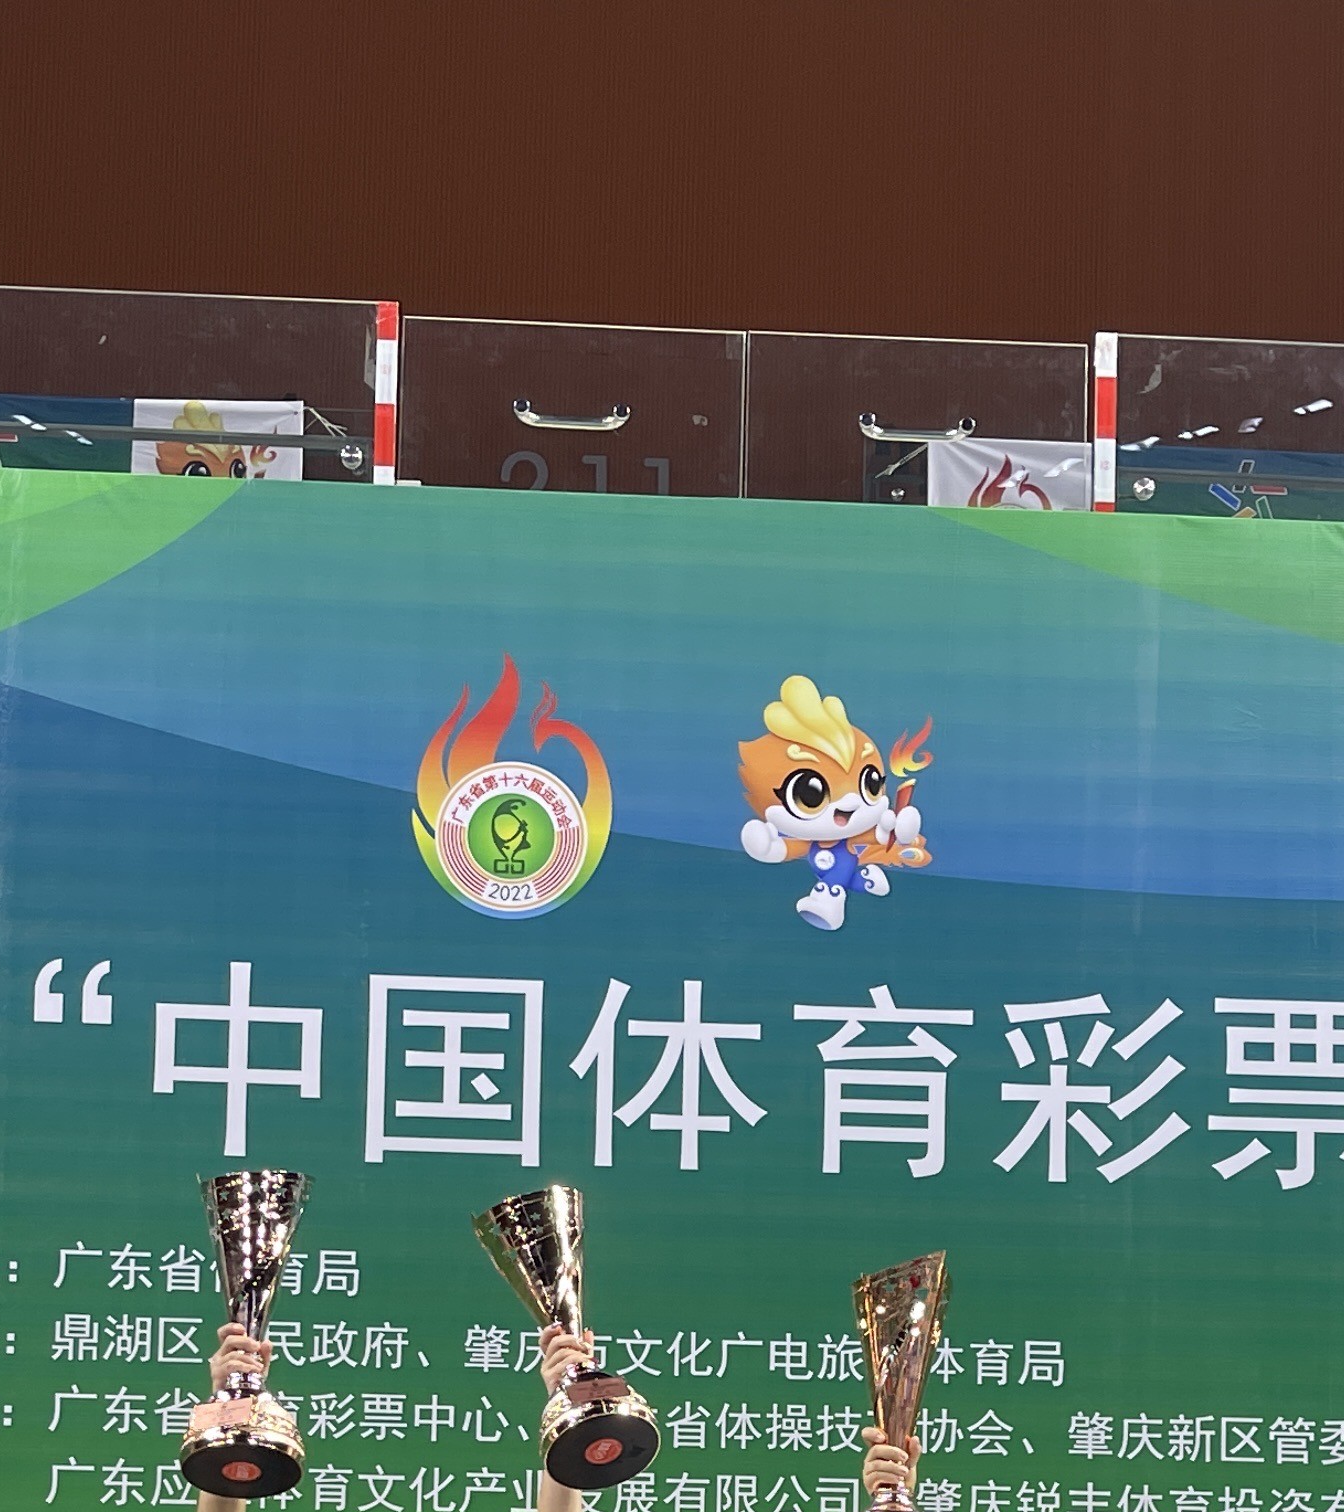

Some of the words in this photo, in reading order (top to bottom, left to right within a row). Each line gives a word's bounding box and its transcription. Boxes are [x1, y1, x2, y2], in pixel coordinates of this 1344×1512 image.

[450, 771, 573, 829] 广东省第十六届运动会
[488, 883, 533, 901] 2022
